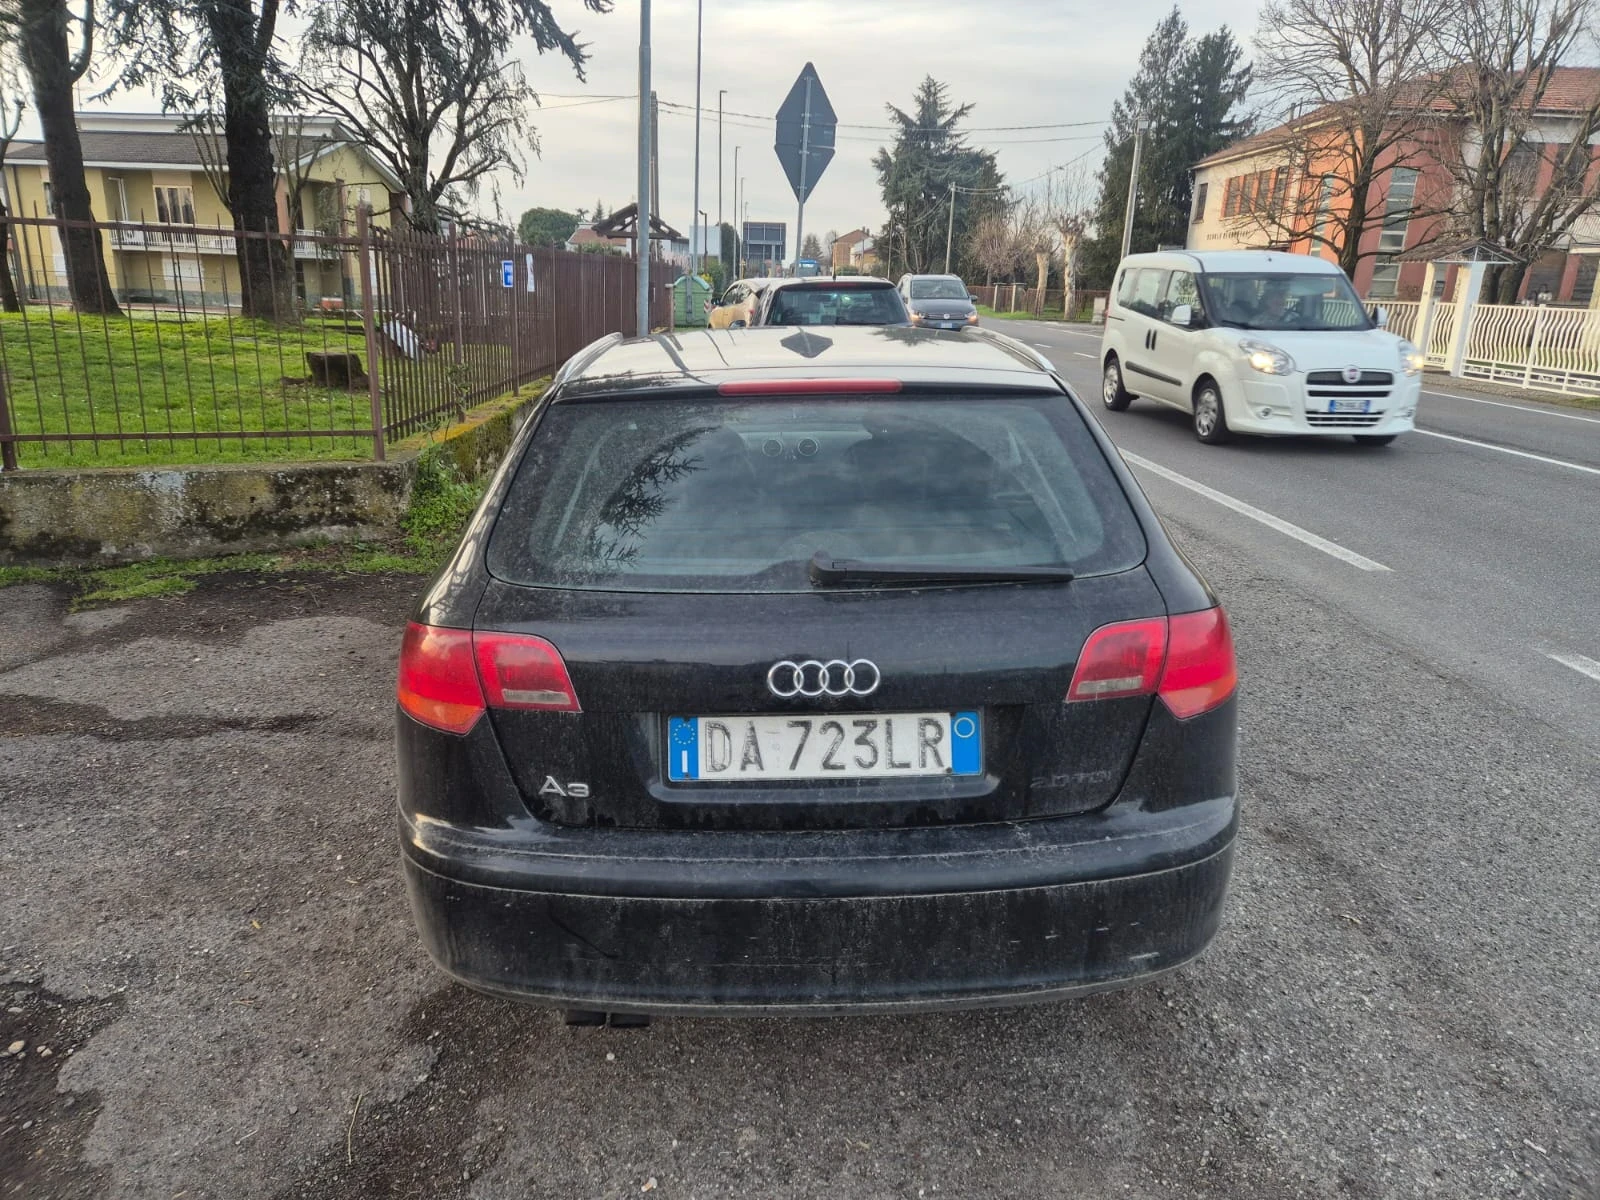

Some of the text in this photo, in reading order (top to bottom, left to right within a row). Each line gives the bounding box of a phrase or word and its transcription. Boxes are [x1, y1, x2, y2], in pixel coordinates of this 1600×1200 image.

[704, 716, 945, 773] DA 723LR
[538, 775, 590, 798] A3
